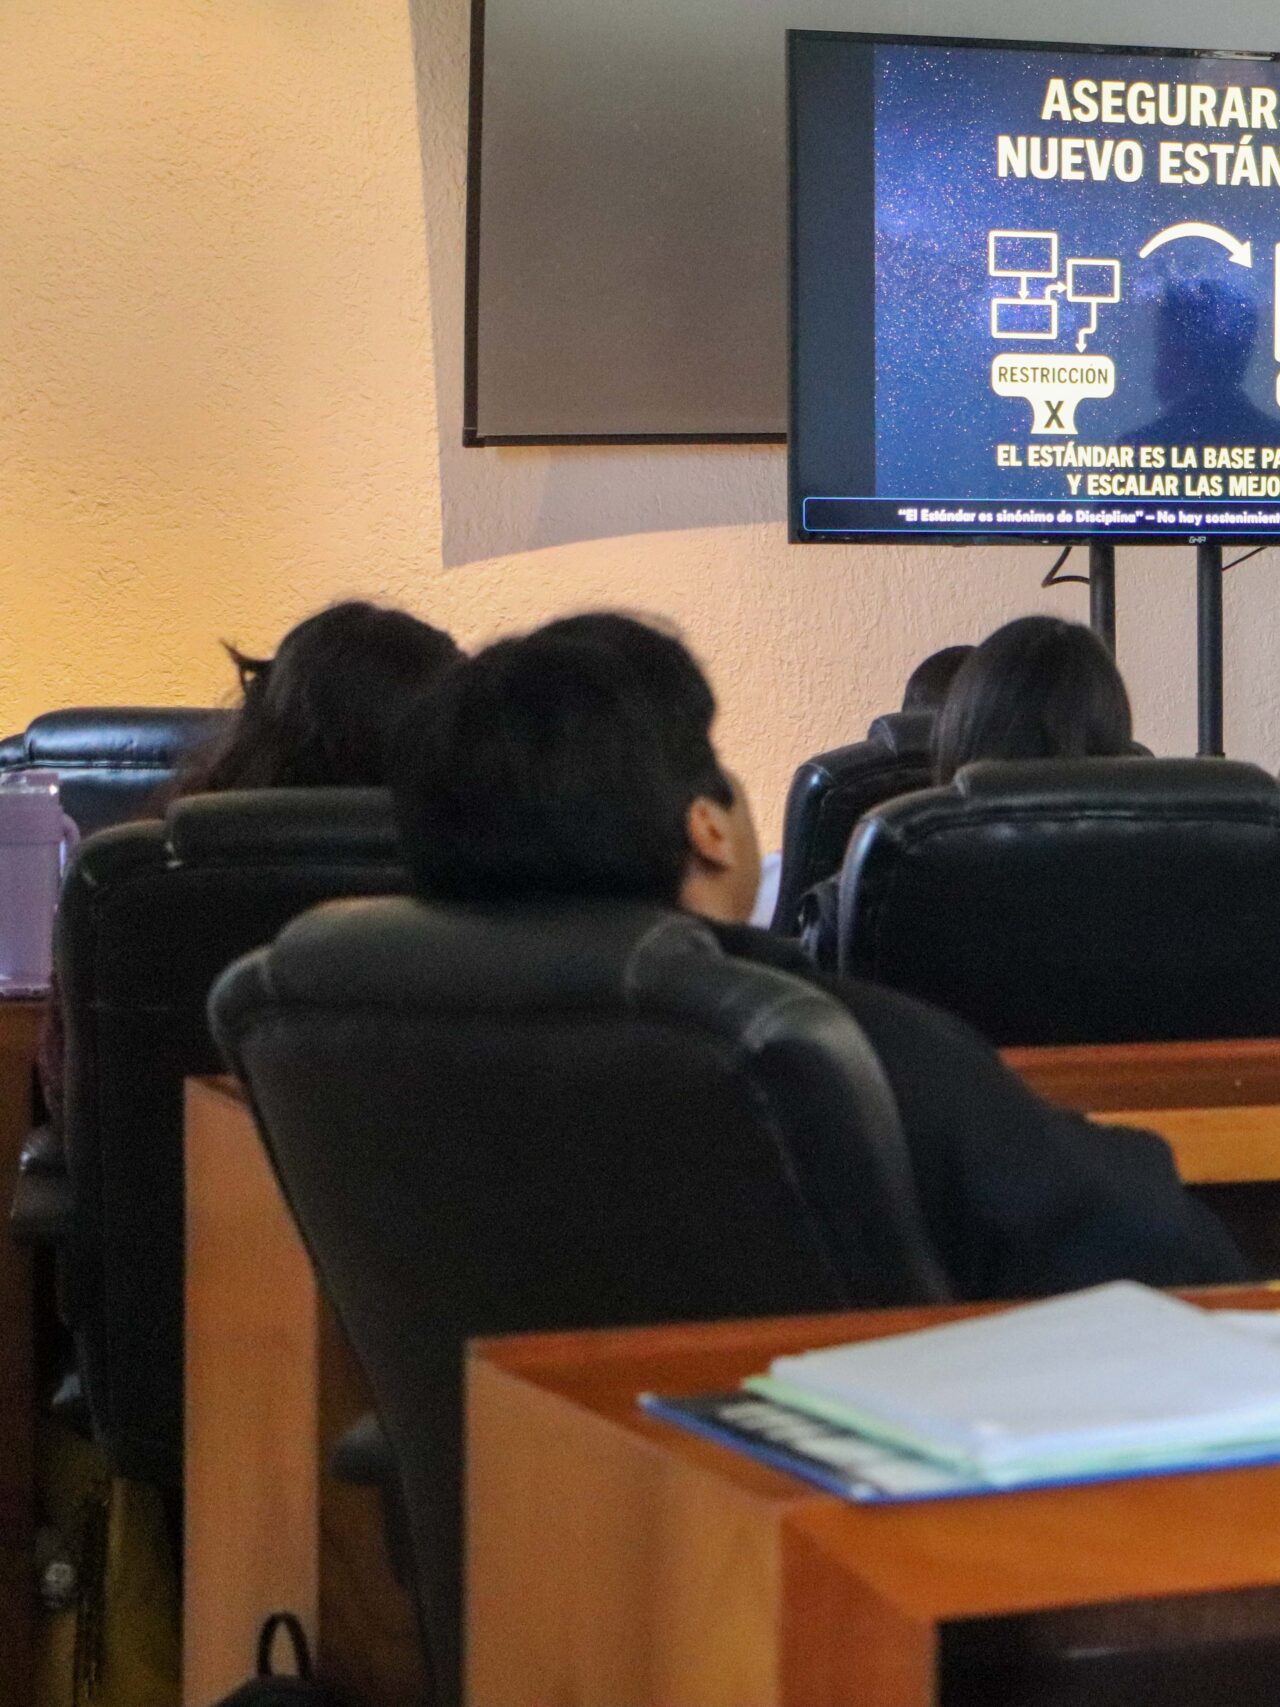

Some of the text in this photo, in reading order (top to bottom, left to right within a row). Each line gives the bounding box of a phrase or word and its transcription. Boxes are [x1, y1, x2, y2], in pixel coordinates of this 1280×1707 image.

[1041, 78, 1278, 129] ASEGURAR
[997, 135, 1144, 183] NUEVO
[998, 363, 1108, 384] RESTRICCIÓN
[1044, 400, 1065, 429] X
[996, 445, 1022, 466] EL
[1028, 441, 1135, 468] ESTÁNDAR
[1140, 447, 1165, 468] ES
[1171, 446, 1198, 469] LA
[1203, 447, 1256, 469] BASE
[1066, 474, 1083, 496] Y
[1087, 474, 1179, 497] ESCALAR
[1185, 475, 1223, 497] LAS
[920, 508, 976, 522] Estándar
[996, 508, 1054, 523] sinónimo
[1157, 510, 1176, 523] No
[1178, 510, 1202, 527] hay
